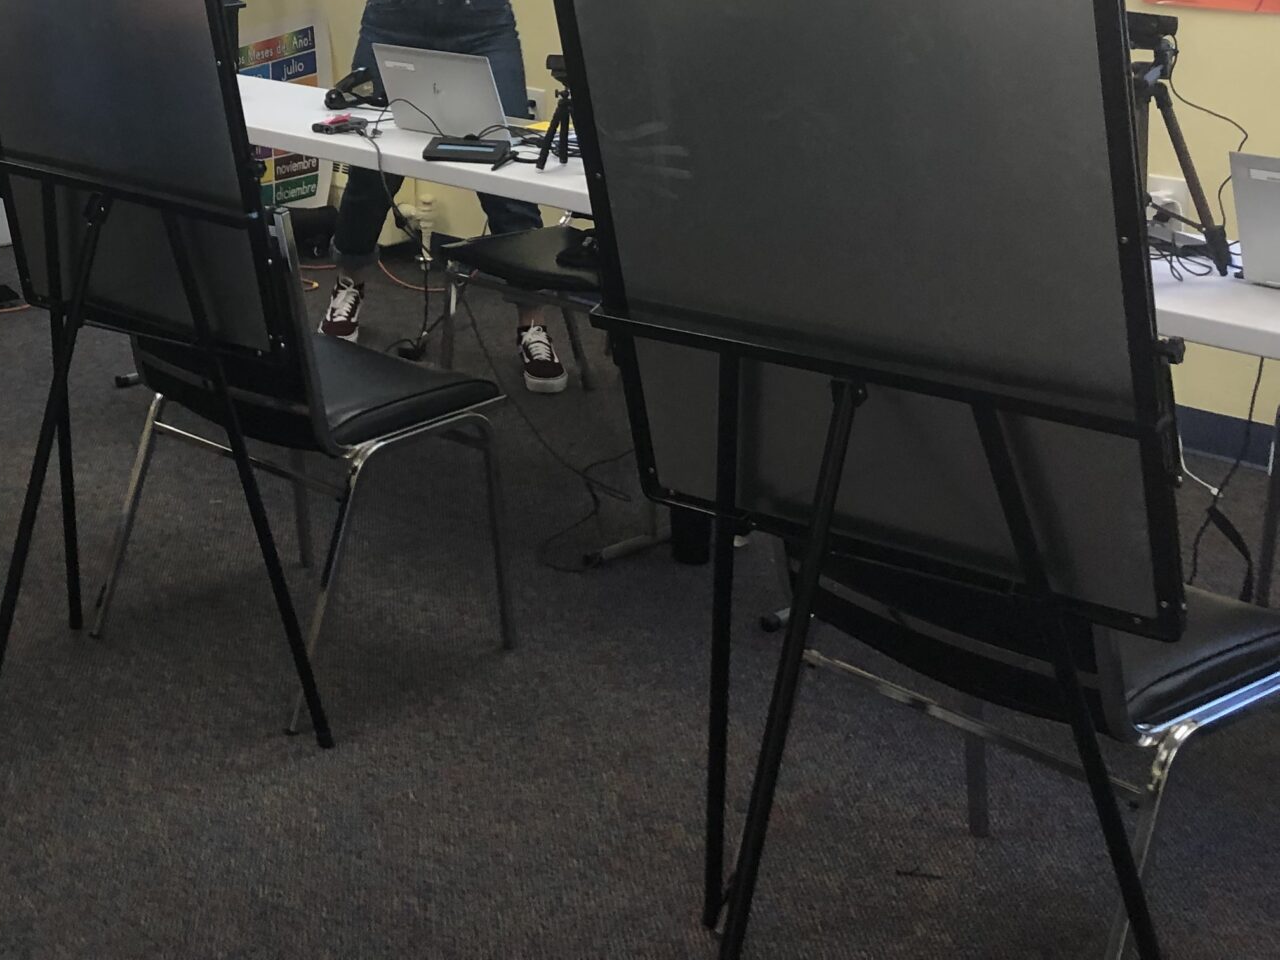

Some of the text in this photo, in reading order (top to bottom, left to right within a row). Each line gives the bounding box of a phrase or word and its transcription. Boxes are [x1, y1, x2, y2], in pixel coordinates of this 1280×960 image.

[248, 47, 273, 62] Meses
[292, 28, 313, 50] Año!
[282, 58, 305, 81] julio
[276, 155, 317, 176] noviembre
[276, 181, 317, 201] diciembre
